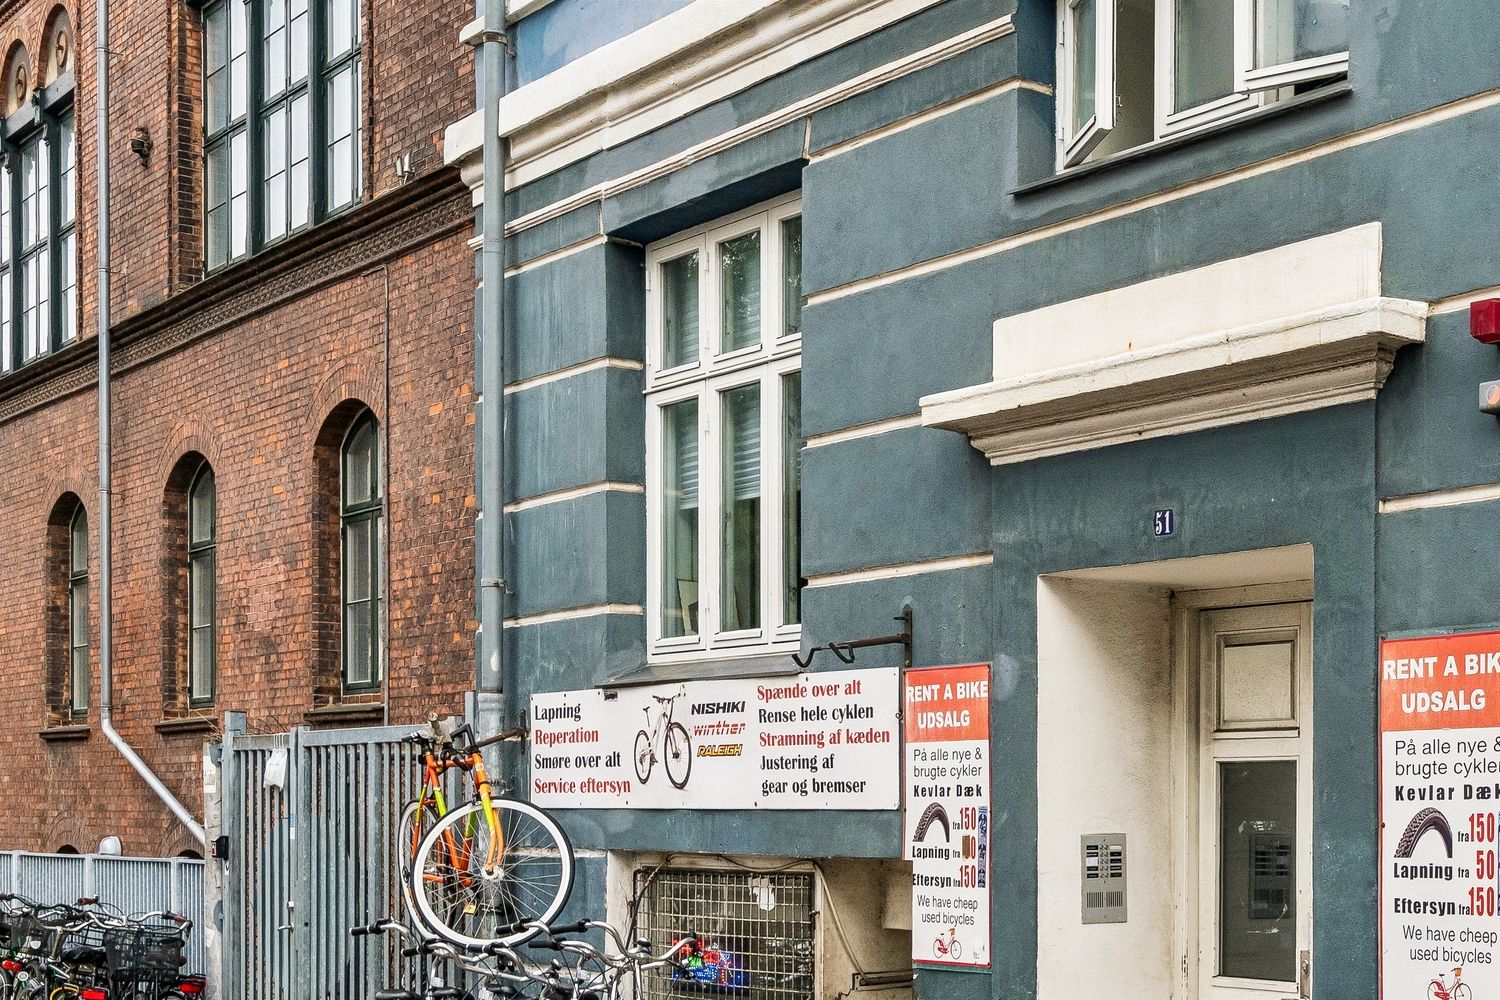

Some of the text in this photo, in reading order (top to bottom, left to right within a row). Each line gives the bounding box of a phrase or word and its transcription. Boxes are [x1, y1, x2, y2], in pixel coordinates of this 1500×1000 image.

[1155, 510, 1170, 535] 51
[1383, 658, 1438, 680] RENT
[1444, 655, 1458, 676] A
[758, 680, 861, 703] Spænde over alt
[906, 681, 988, 702] RENT A BIKE
[691, 701, 745, 715] NISHIKI
[1401, 689, 1485, 714] UDSALG
[535, 703, 581, 723] Lapning
[759, 704, 873, 723] Rense hele cyklen
[917, 710, 970, 729] UDSALG
[536, 729, 598, 747] Reperation
[694, 721, 745, 736] winther
[760, 728, 889, 748] Stramning af kæden
[697, 744, 743, 757] RALEIGH
[914, 747, 982, 763] På alle nye &
[1396, 739, 1416, 755] På
[1423, 739, 1450, 754] alle
[1458, 741, 1486, 757] nye
[535, 751, 620, 769] Smøre over alt
[761, 754, 834, 773] Justering af
[914, 764, 982, 780] brugte cykler
[1396, 761, 1447, 779] brugte
[535, 778, 630, 796] Service eftersyn
[762, 778, 866, 796] gear og bremser
[914, 785, 982, 797] Kevlar Dæk
[1396, 785, 1454, 801] Kevlar
[960, 807, 976, 830] 150
[1458, 813, 1494, 842] fra 150
[912, 845, 950, 861] Lapning
[962, 836, 976, 859] 0
[1394, 850, 1494, 880] Lapning fra 50
[912, 873, 951, 889] Eftersyn
[960, 865, 976, 888] 150
[917, 895, 978, 912] We have cheep
[1395, 887, 1494, 916] Eftersyn fra 150
[922, 912, 974, 927] used bicycles
[1403, 925, 1497, 947] We have cheep
[1410, 947, 1491, 966] used bicycles
